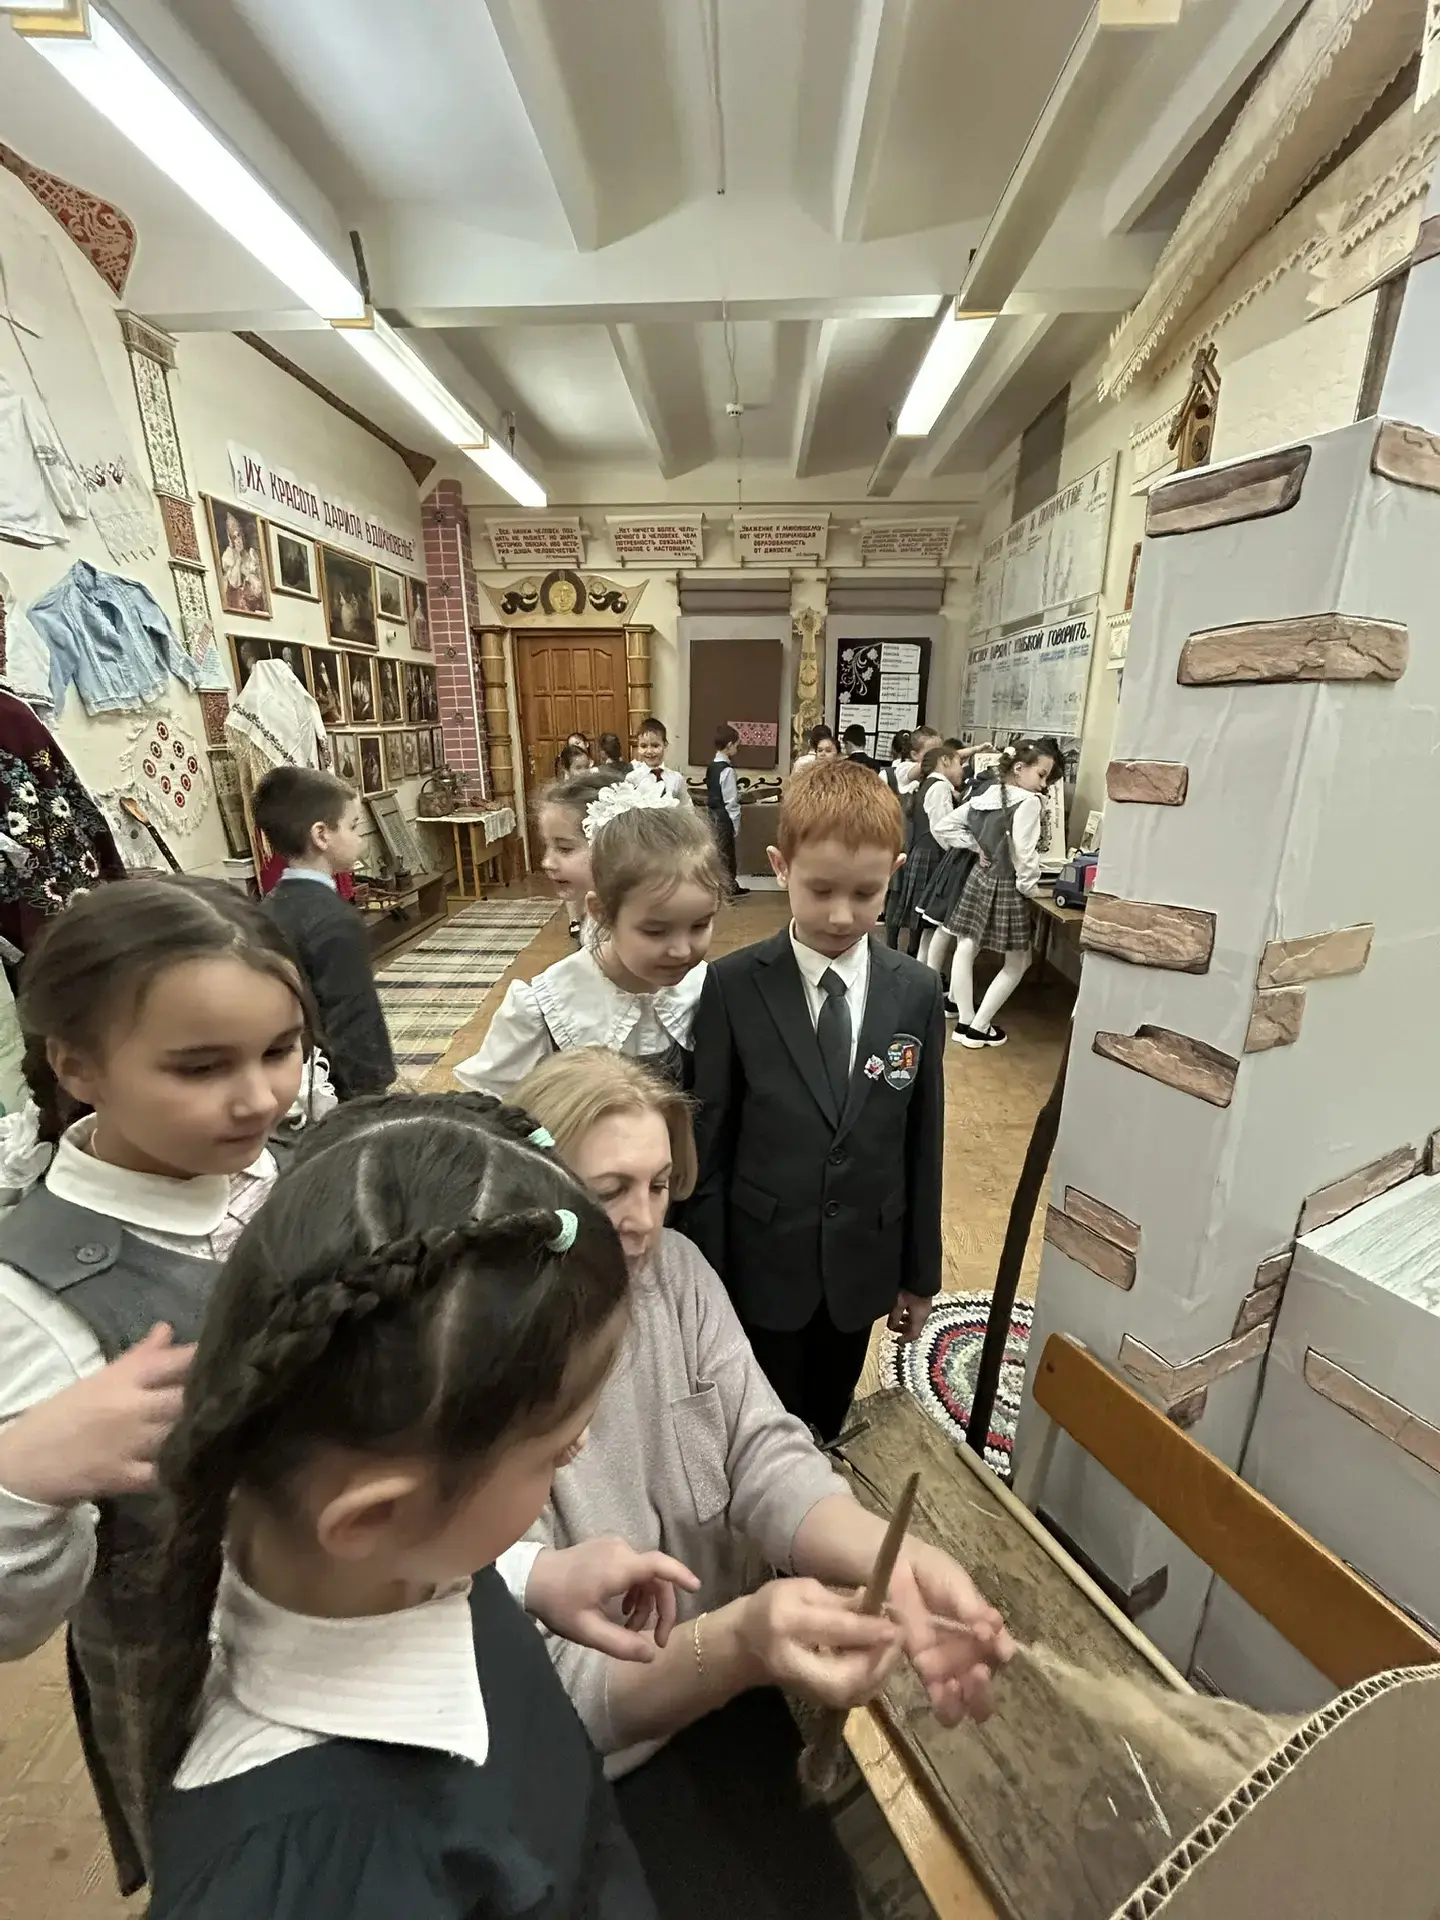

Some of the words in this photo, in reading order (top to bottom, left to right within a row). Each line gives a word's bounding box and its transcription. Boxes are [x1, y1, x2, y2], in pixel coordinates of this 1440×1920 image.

[243, 455, 266, 496] ИХ
[269, 471, 321, 521] КРАСОТА
[323, 500, 363, 541] ДАРИЛА
